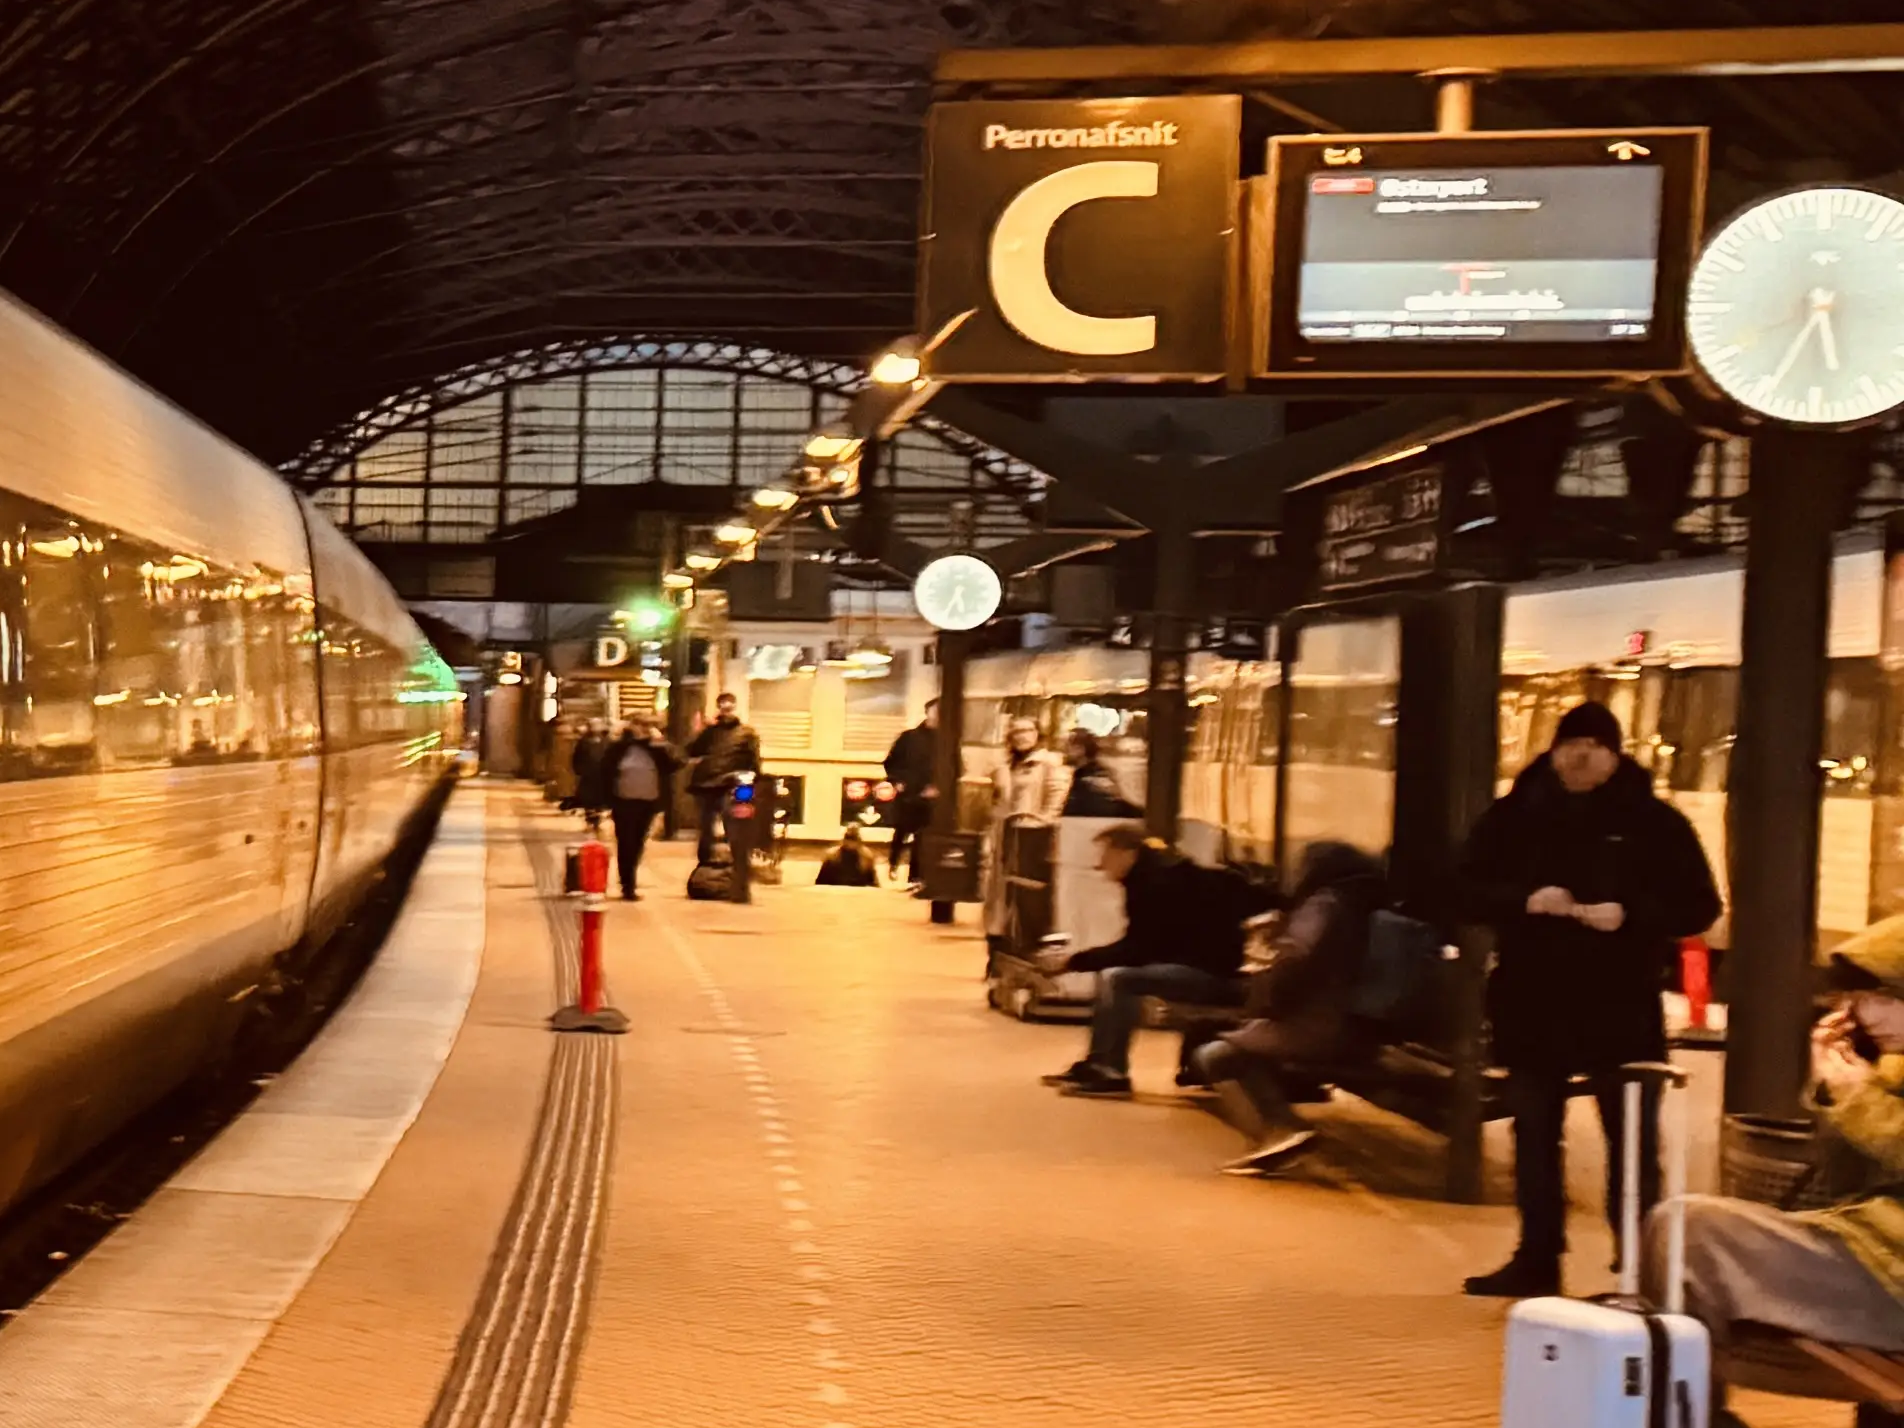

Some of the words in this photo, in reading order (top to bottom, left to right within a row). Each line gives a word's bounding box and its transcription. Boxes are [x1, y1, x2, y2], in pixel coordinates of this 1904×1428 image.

[984, 120, 1179, 150] Perronafsnit
[989, 159, 1160, 356] C
[596, 636, 629, 668] D
